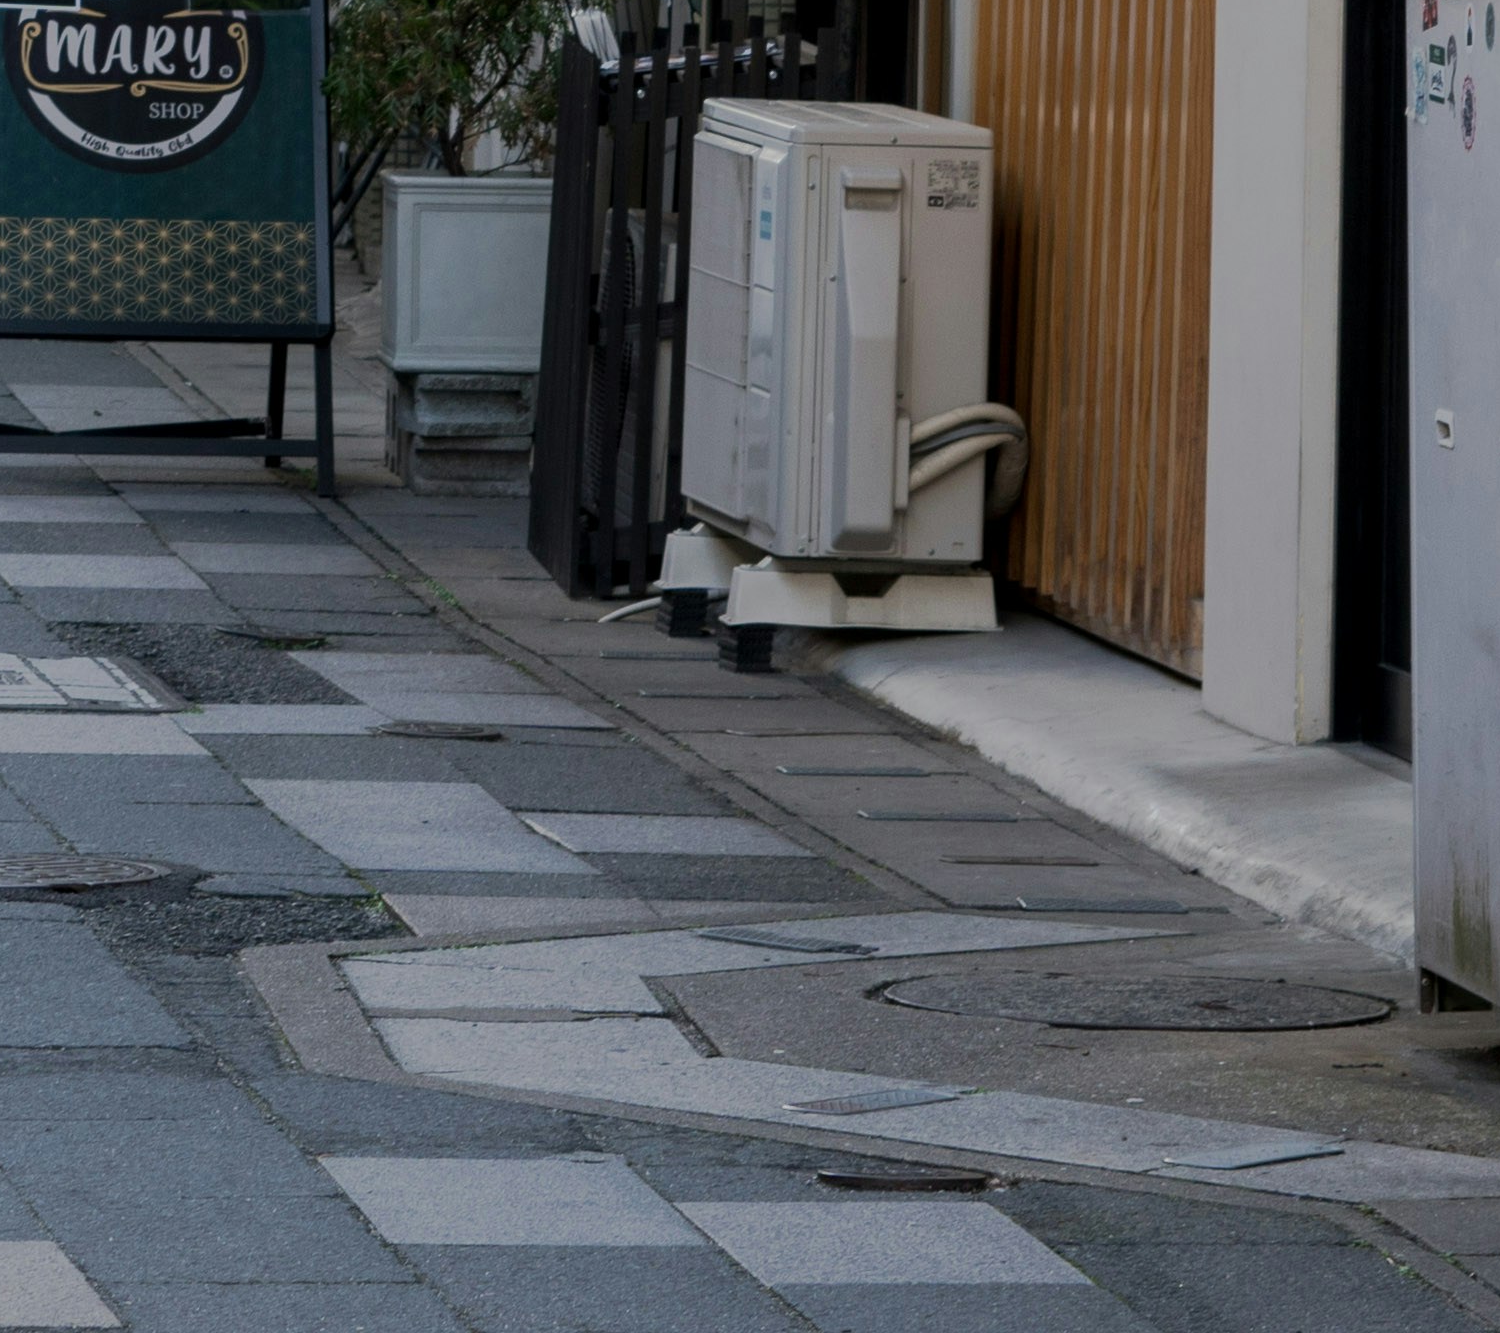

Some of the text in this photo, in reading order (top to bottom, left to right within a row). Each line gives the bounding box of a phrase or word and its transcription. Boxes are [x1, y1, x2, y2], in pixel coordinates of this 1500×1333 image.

[45, 19, 212, 80] MARY
[149, 102, 204, 120] SHOP
[81, 131, 194, 158] High Quality Cbd
